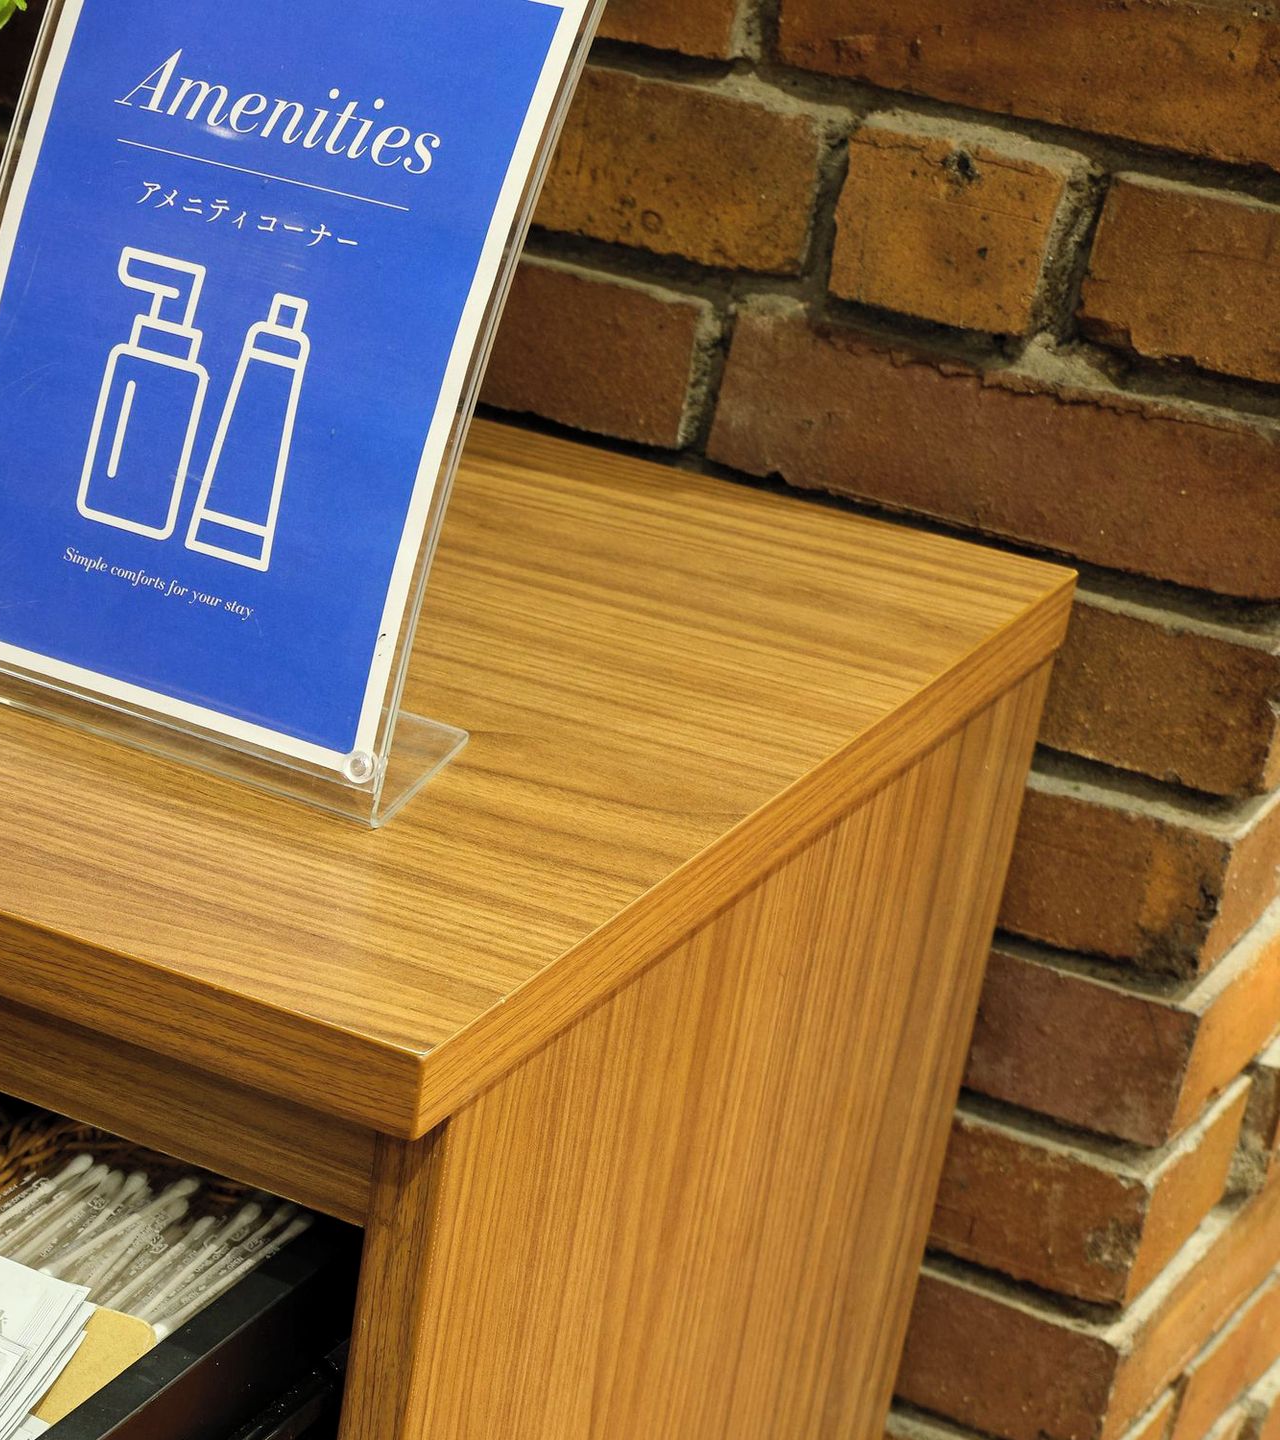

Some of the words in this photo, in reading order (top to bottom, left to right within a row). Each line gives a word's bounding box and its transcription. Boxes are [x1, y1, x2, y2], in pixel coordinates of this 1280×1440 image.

[114, 48, 441, 175] Amenities
[136, 181, 359, 247] アメニティコーナー
[63, 547, 108, 572] Simple
[110, 569, 166, 591] comforts
[163, 580, 189, 597] for
[188, 590, 223, 608] your
[224, 600, 255, 621] stay
